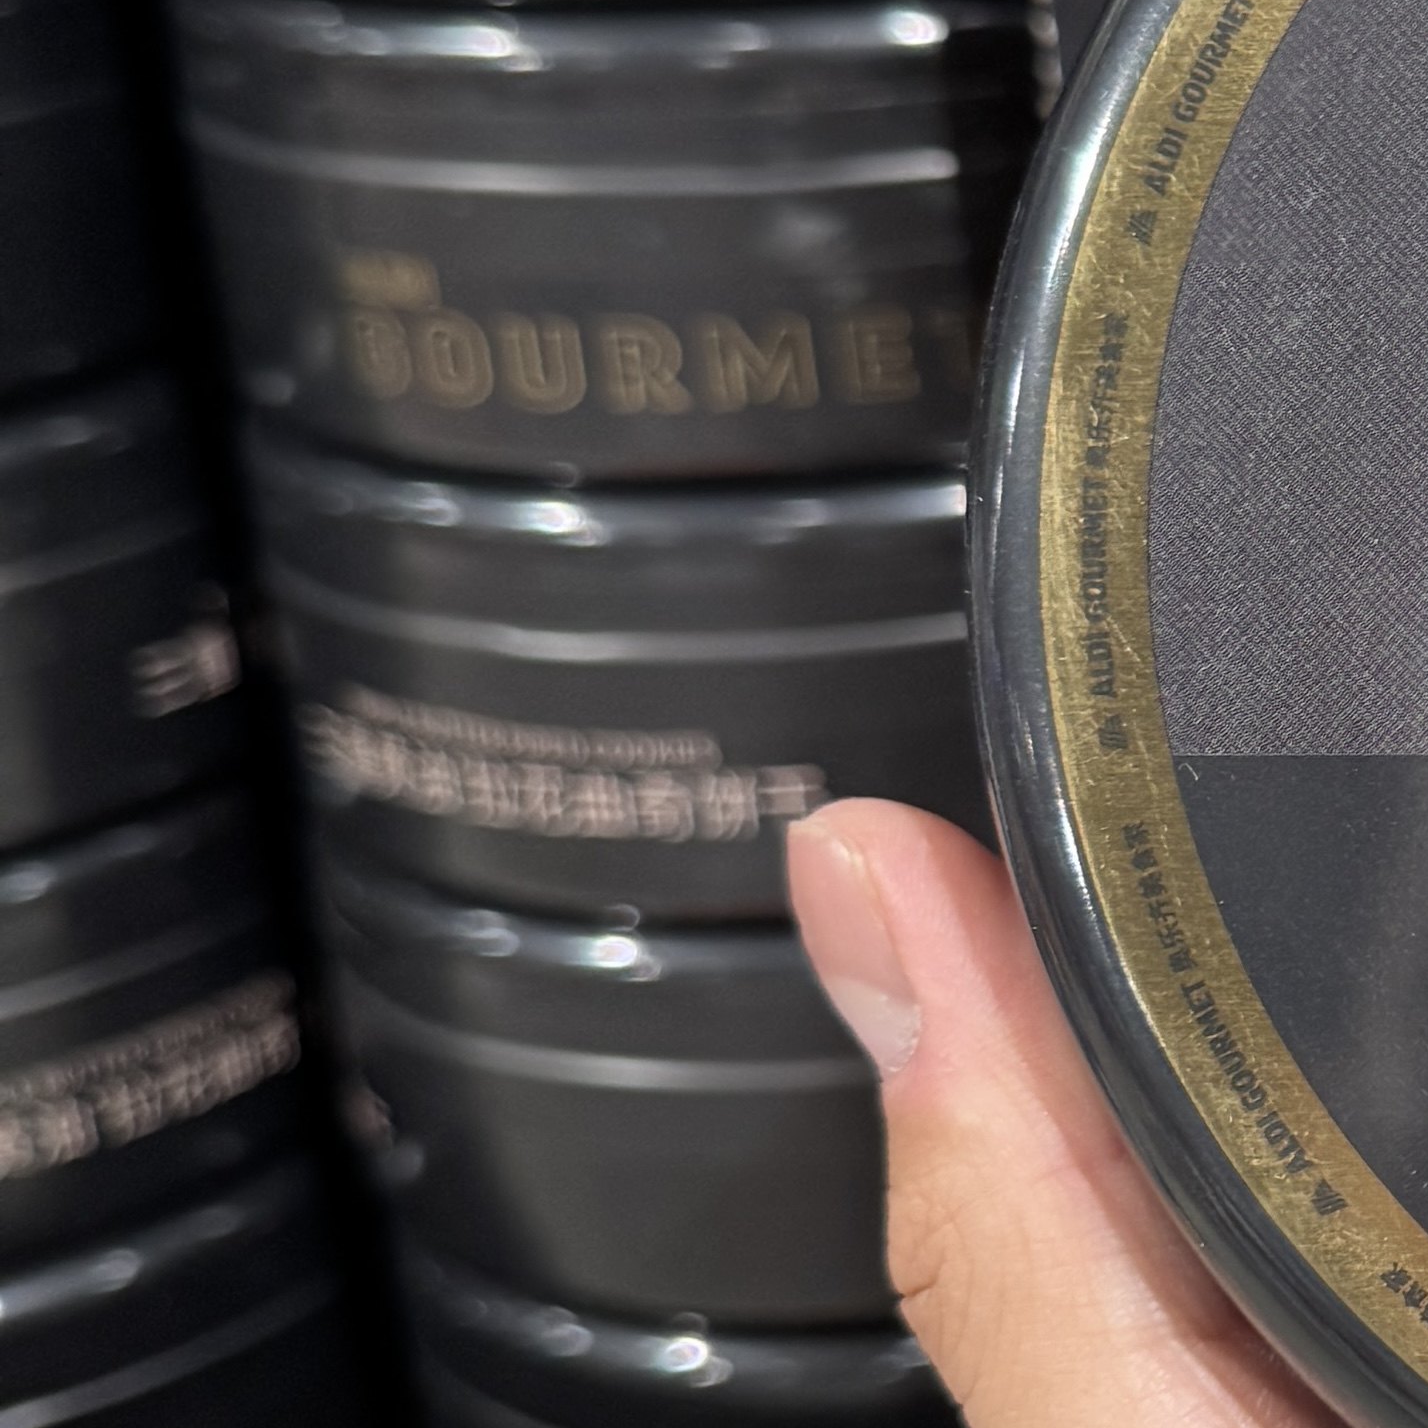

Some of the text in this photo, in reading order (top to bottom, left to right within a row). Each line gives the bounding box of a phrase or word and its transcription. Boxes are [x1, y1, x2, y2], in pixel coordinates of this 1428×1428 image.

[1142, 127, 1188, 197] ALDI
[1180, 979, 1265, 1113] GOURMET
[1255, 1110, 1313, 1174] ALDI
